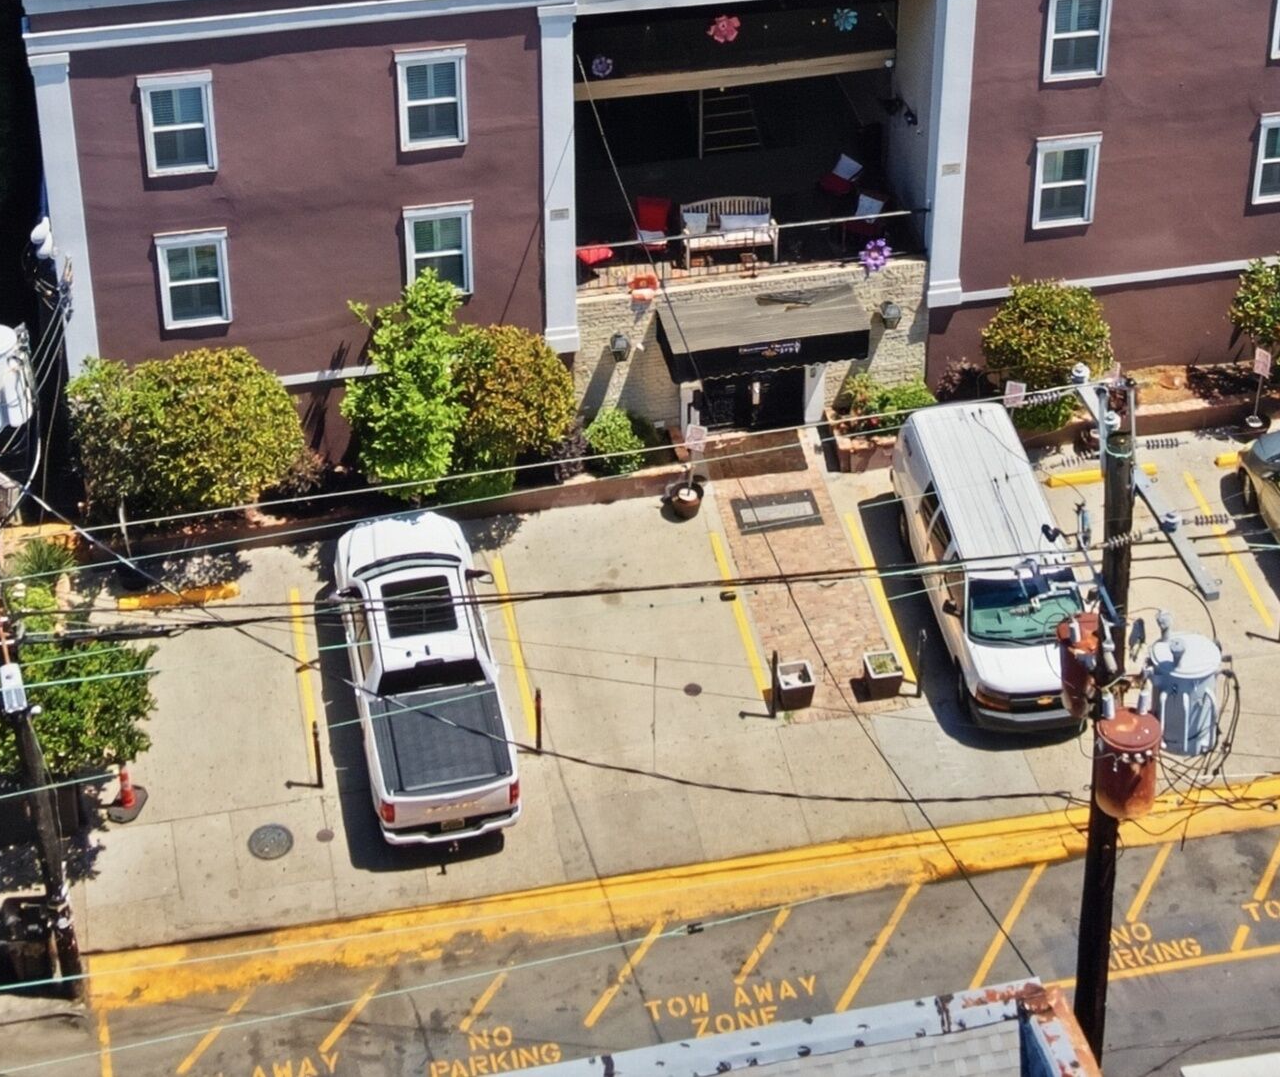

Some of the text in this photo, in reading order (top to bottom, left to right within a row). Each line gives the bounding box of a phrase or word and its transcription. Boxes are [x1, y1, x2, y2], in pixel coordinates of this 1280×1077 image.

[1110, 922, 1152, 947] NO
[1108, 937, 1202, 970] RKING
[644, 975, 817, 1021] TOW AWAY
[468, 1025, 513, 1051] NO
[691, 1005, 778, 1039] ZONE
[429, 1042, 562, 1077] PARKING
